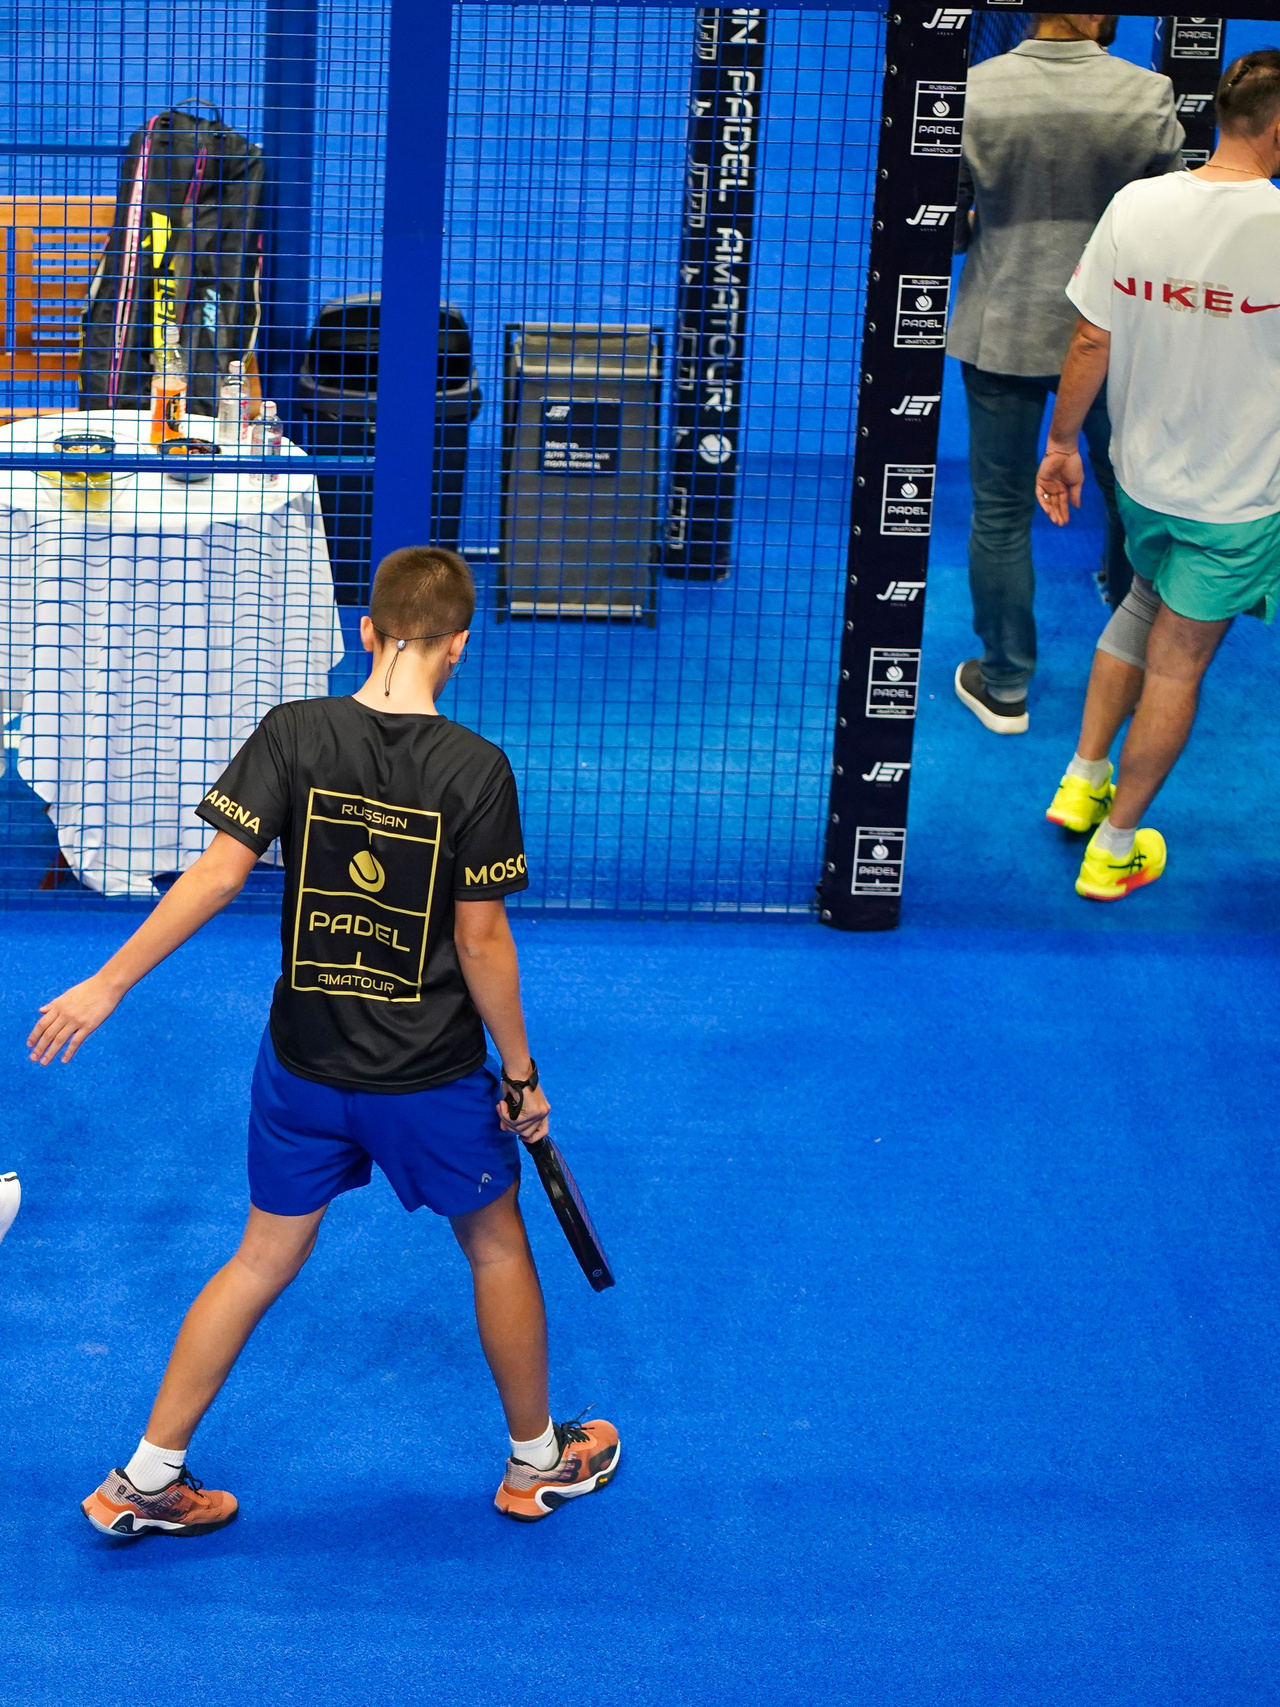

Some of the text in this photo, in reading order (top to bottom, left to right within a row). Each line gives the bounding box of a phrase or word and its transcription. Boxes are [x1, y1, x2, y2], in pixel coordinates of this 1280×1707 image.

[922, 8, 973, 30] JET
[718, 70, 756, 202] PADEL
[918, 125, 961, 135] PADEL
[905, 204, 958, 226] JET
[1113, 277, 1234, 315] NIKE
[704, 227, 744, 412] AMATOUR
[901, 319, 943, 329] PADEL
[889, 395, 941, 416] JET
[887, 505, 928, 516] PADEL
[876, 581, 927, 602] JET
[873, 688, 914, 699] PADEL
[861, 761, 912, 783] JET
[204, 789, 261, 835] ARENA
[341, 803, 408, 829] RUSSIAN
[858, 865, 899, 877] PADEL
[308, 910, 411, 952] PADEL
[317, 973, 395, 995] AMATOUR
